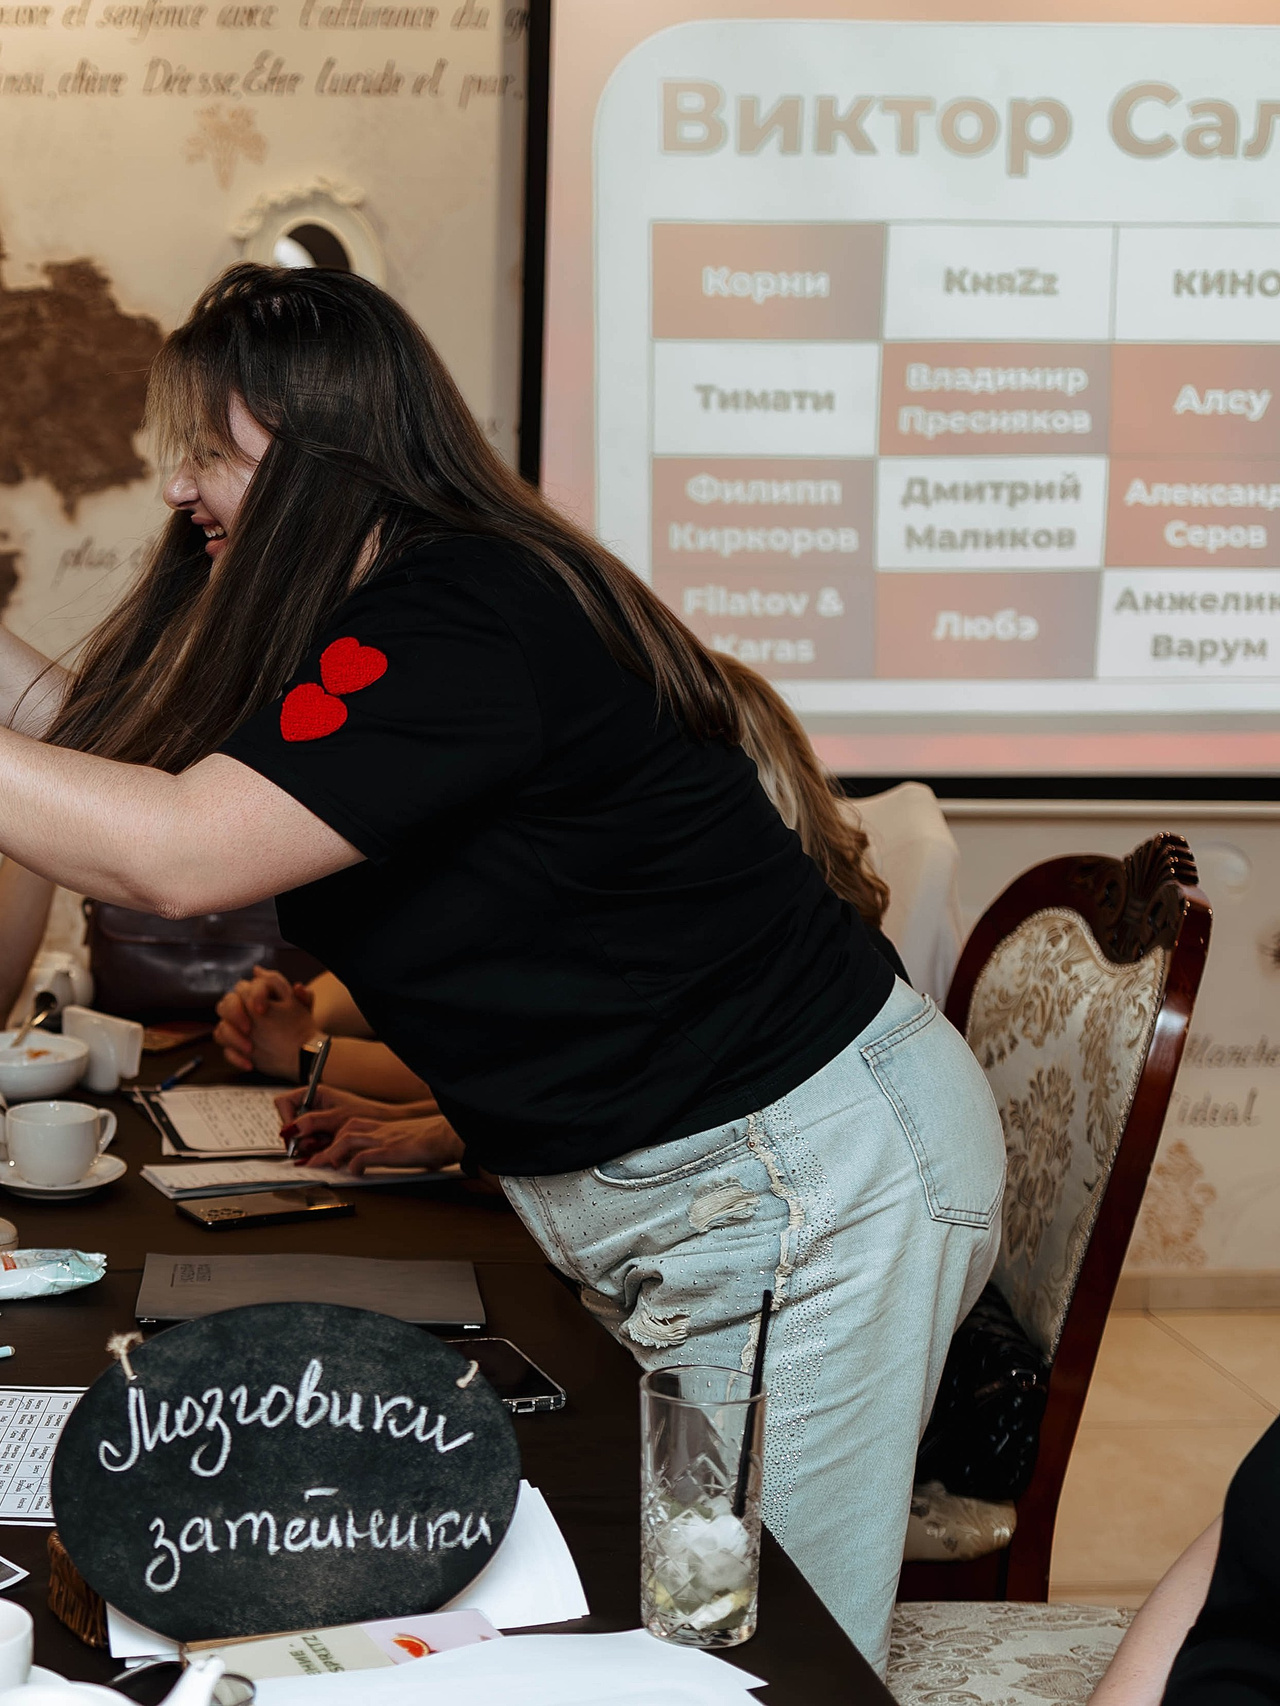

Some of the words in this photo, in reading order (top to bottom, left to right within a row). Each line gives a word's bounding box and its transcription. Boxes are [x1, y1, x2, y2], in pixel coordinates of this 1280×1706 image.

[659, 78, 1074, 177] Виктор
[702, 265, 832, 303] Корни
[1173, 269, 1280, 298] КИНО
[906, 363, 1089, 398] Владимир
[694, 383, 836, 415] Тимати
[1173, 384, 1271, 421] Алсу
[898, 406, 1093, 439] Пресняков
[686, 472, 842, 506] Филипп
[901, 471, 1082, 509] Дмитрий
[668, 522, 860, 559] Киркоров
[904, 524, 1077, 554] Маликов
[1163, 519, 1268, 555] Серов
[683, 584, 810, 617] Filatov
[817, 586, 846, 617] &
[932, 608, 1039, 642] Любэ
[1150, 633, 1268, 668] Варум
[98, 1358, 475, 1477] Мозговики
[144, 1487, 493, 1593] затейники
[301, 1634, 346, 1673] SPRITZ
